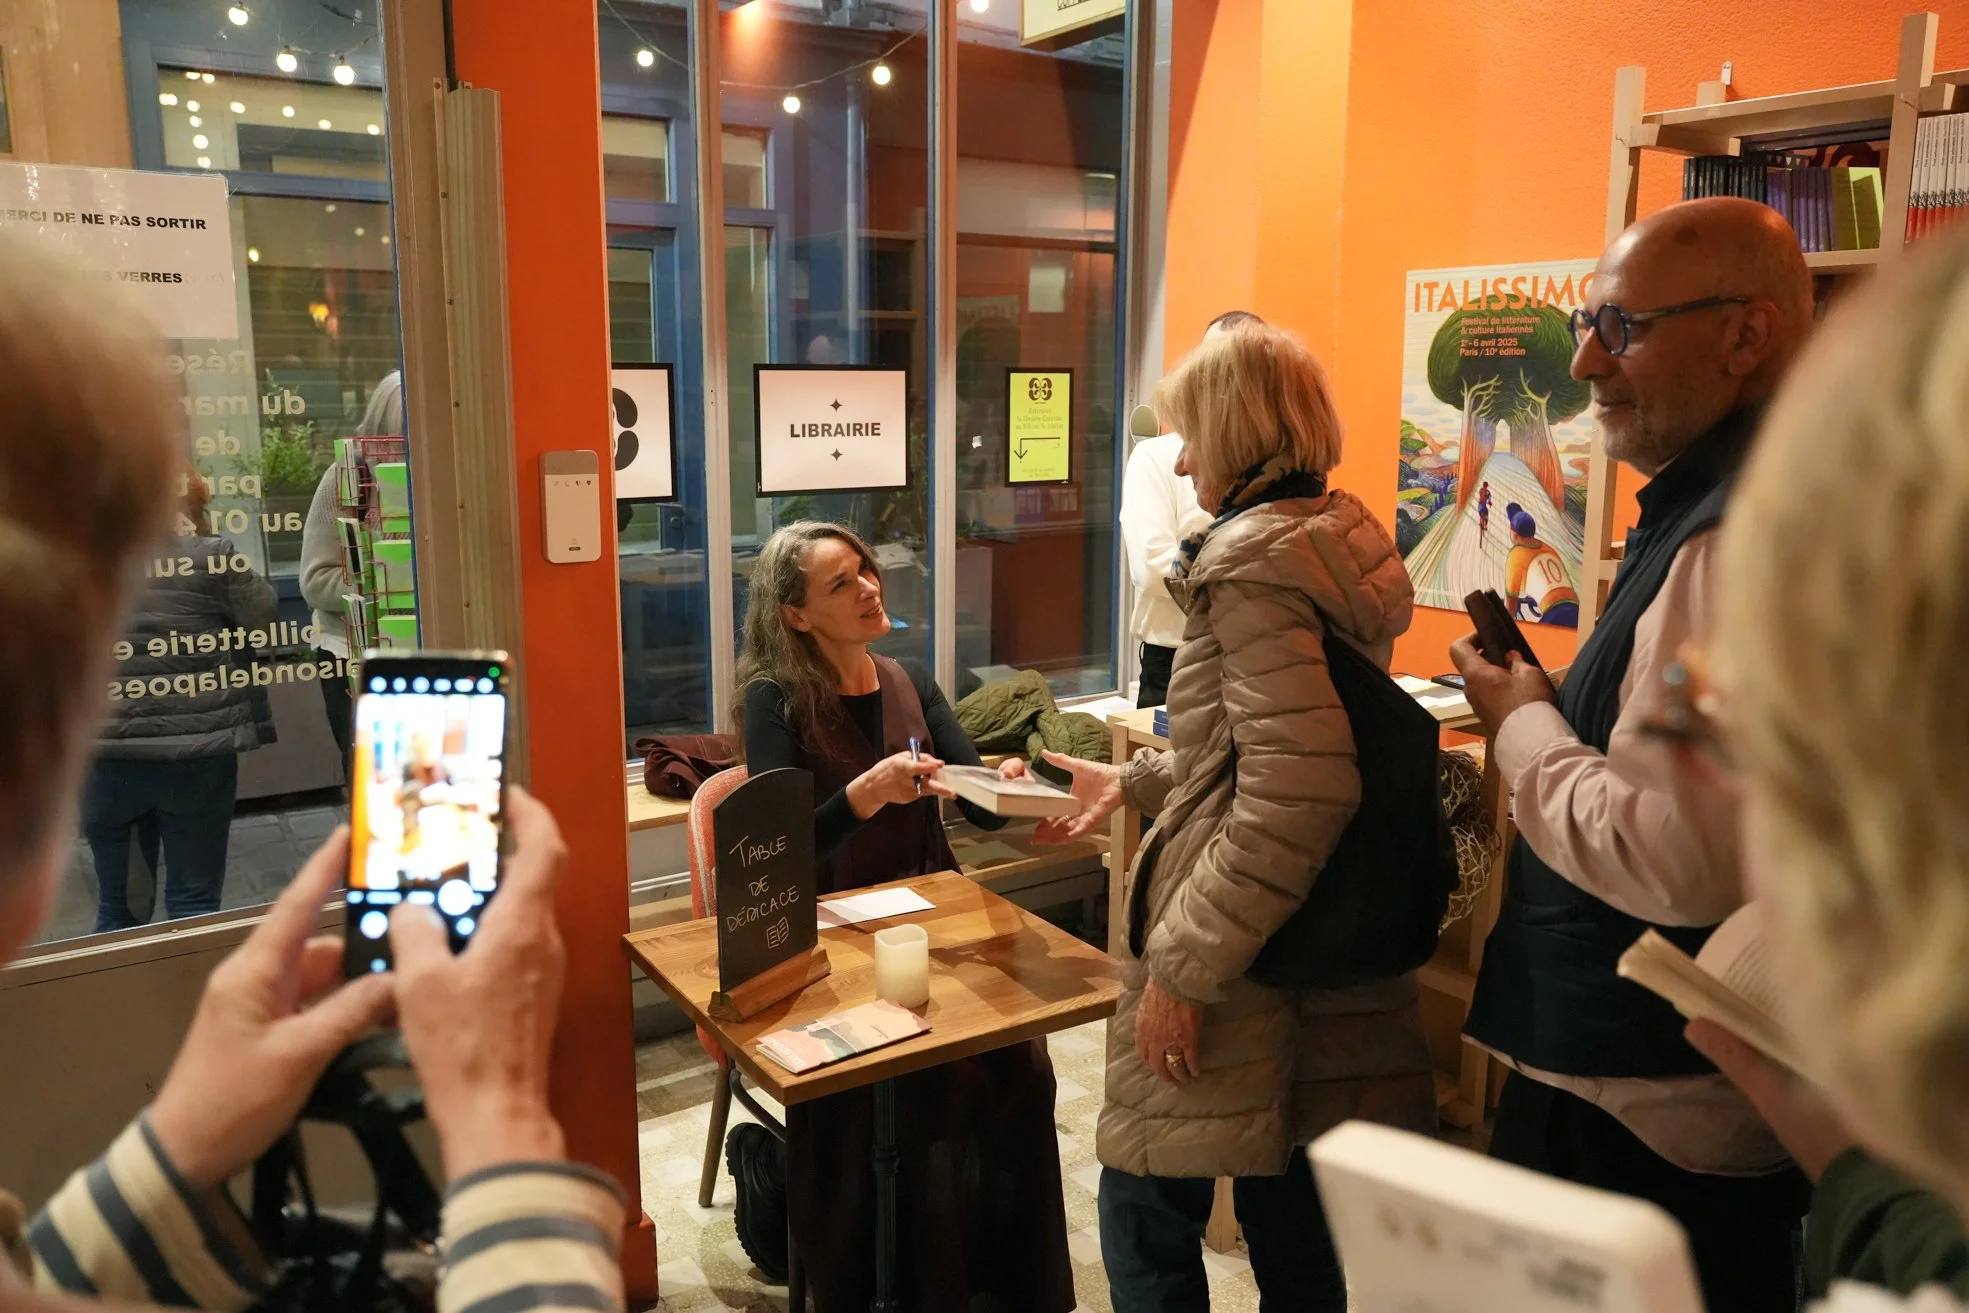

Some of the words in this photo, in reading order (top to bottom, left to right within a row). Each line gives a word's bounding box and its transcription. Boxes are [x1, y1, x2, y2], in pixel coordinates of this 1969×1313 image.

[53, 211, 76, 224] DE
[81, 213, 105, 225] NE
[109, 214, 141, 227] PAS
[146, 216, 207, 230] SORTIR
[117, 270, 183, 284] VERRES
[1461, 316, 1489, 326] Festival
[1490, 316, 1500, 325] de
[1501, 315, 1541, 325] littérature
[1460, 326, 1467, 335] &
[1468, 326, 1495, 335] culture
[1496, 325, 1534, 334] italiennes
[1473, 338, 1479, 347] 6
[1480, 338, 1496, 347] avril
[1497, 338, 1518, 347] 2025
[1460, 347, 1478, 357] Paris
[1499, 347, 1526, 356] édition
[790, 422, 881, 438] LIBRAIRIE
[1538, 560, 1562, 585] 10
[729, 835, 787, 868] TABLE
[748, 874, 770, 897] DE
